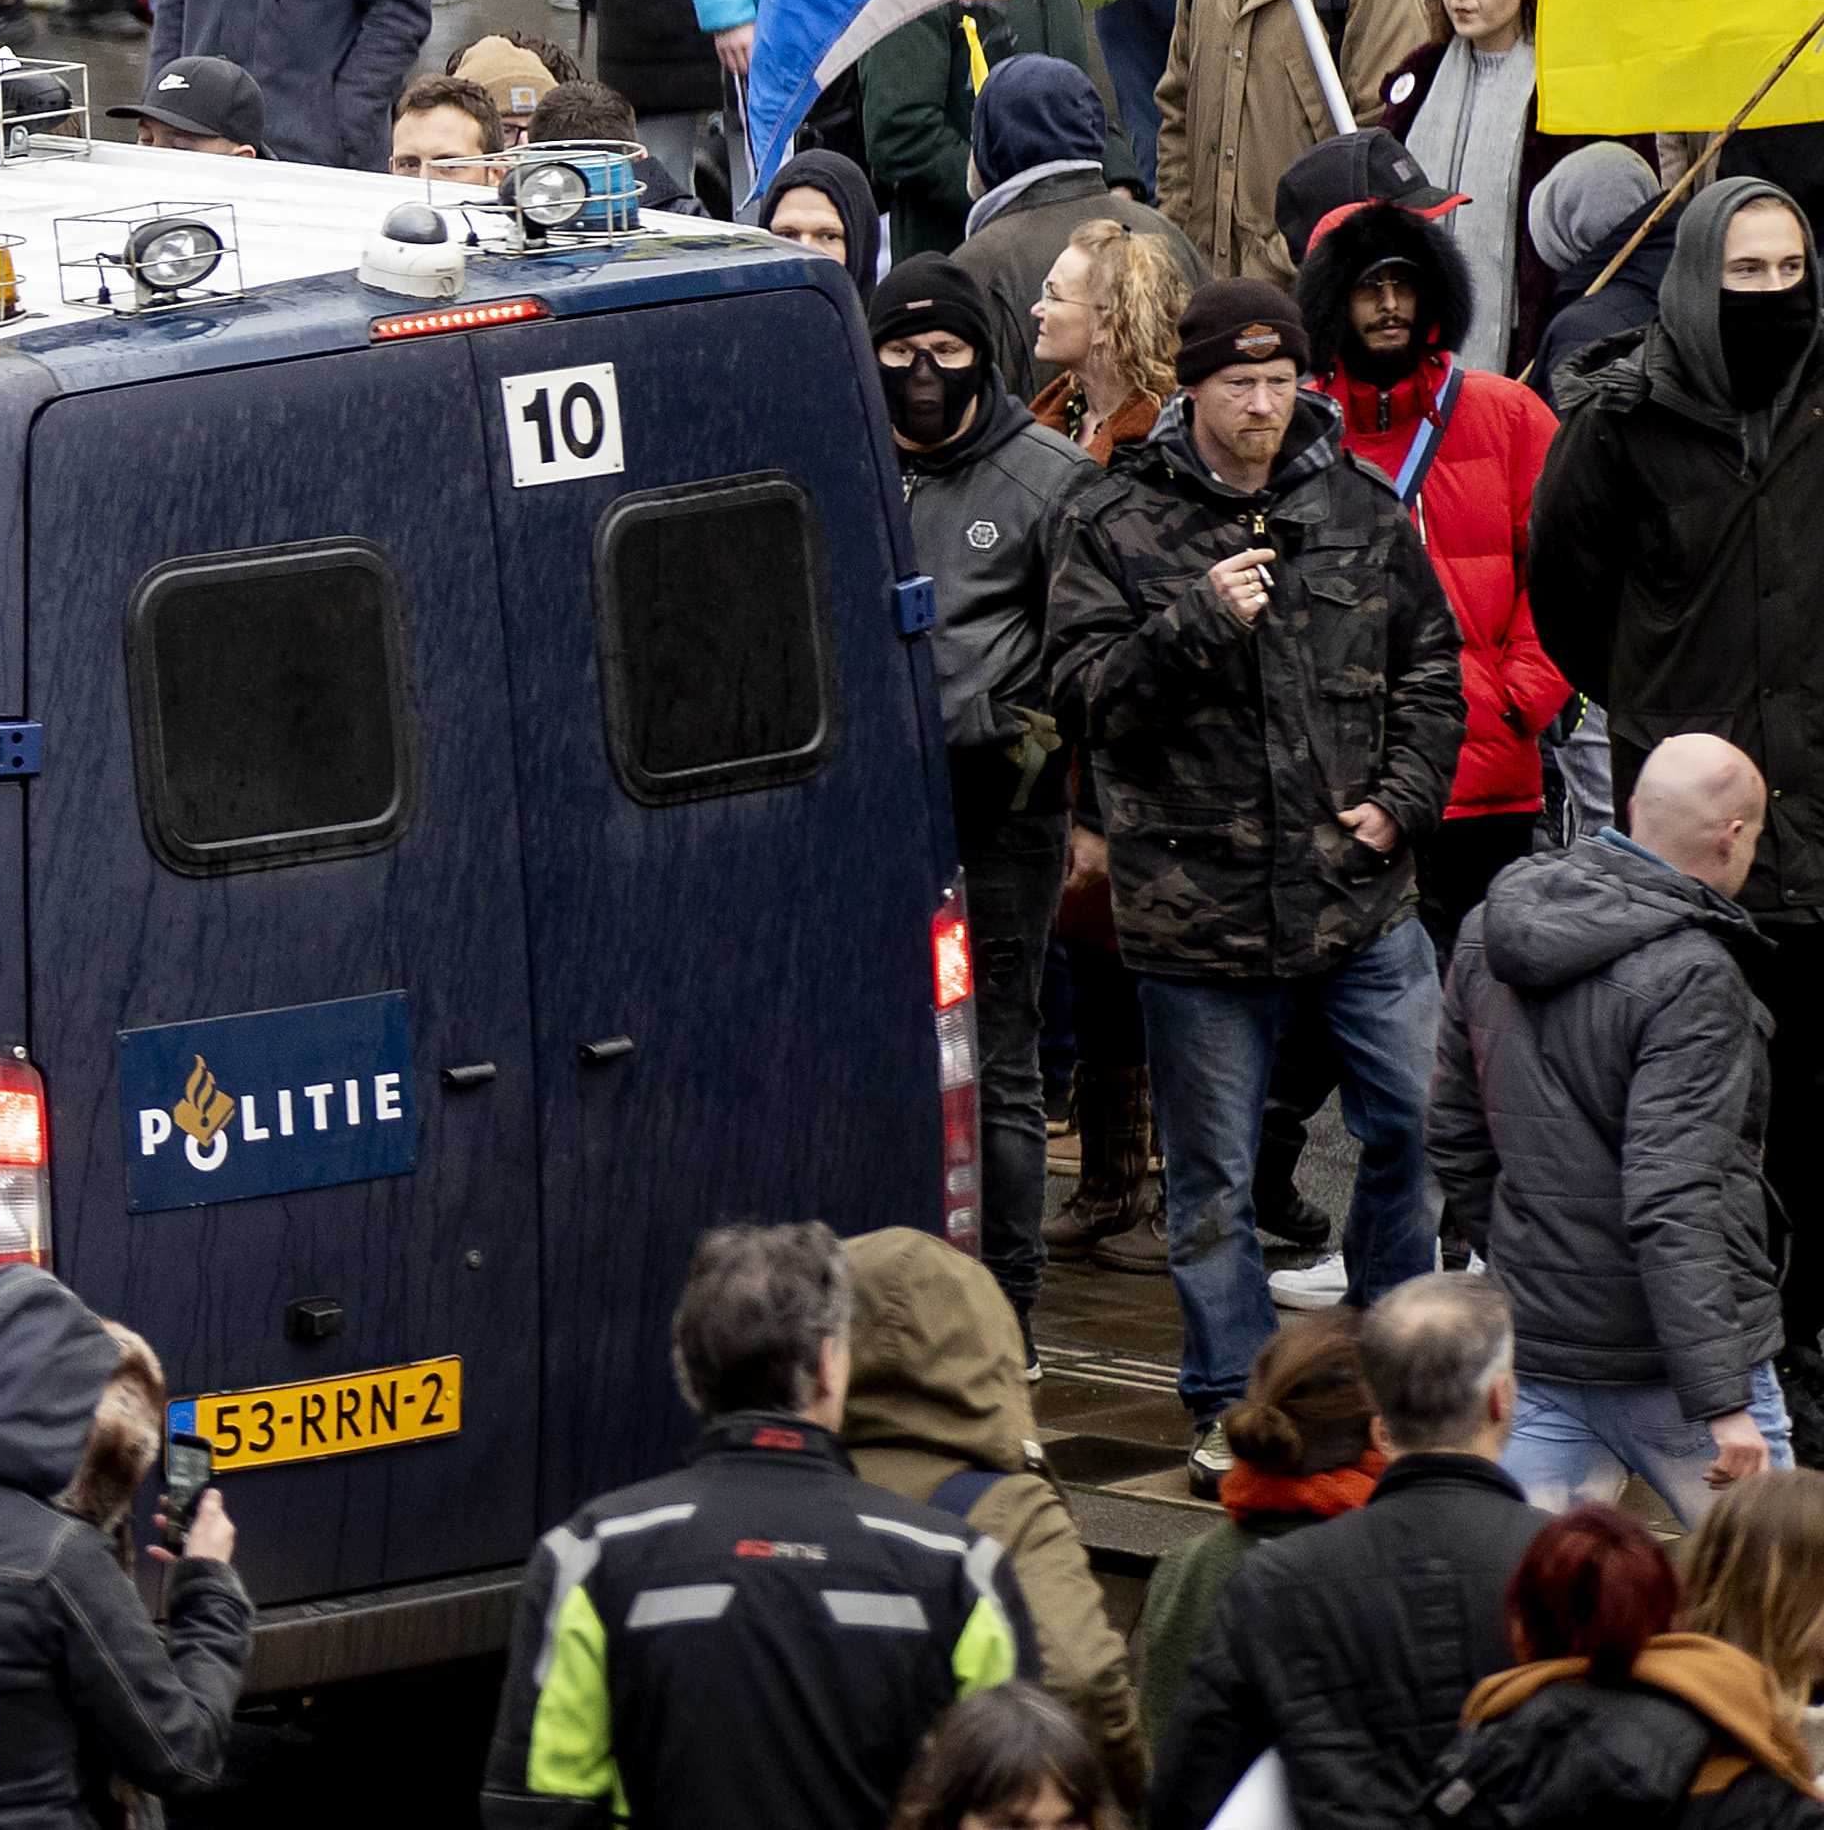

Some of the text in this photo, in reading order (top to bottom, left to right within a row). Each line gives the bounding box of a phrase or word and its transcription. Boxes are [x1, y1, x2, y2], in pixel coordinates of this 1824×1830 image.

[522, 381, 604, 463] 10
[139, 1072, 402, 1171] POLITIE
[213, 1372, 444, 1457] 53-RRN-2
